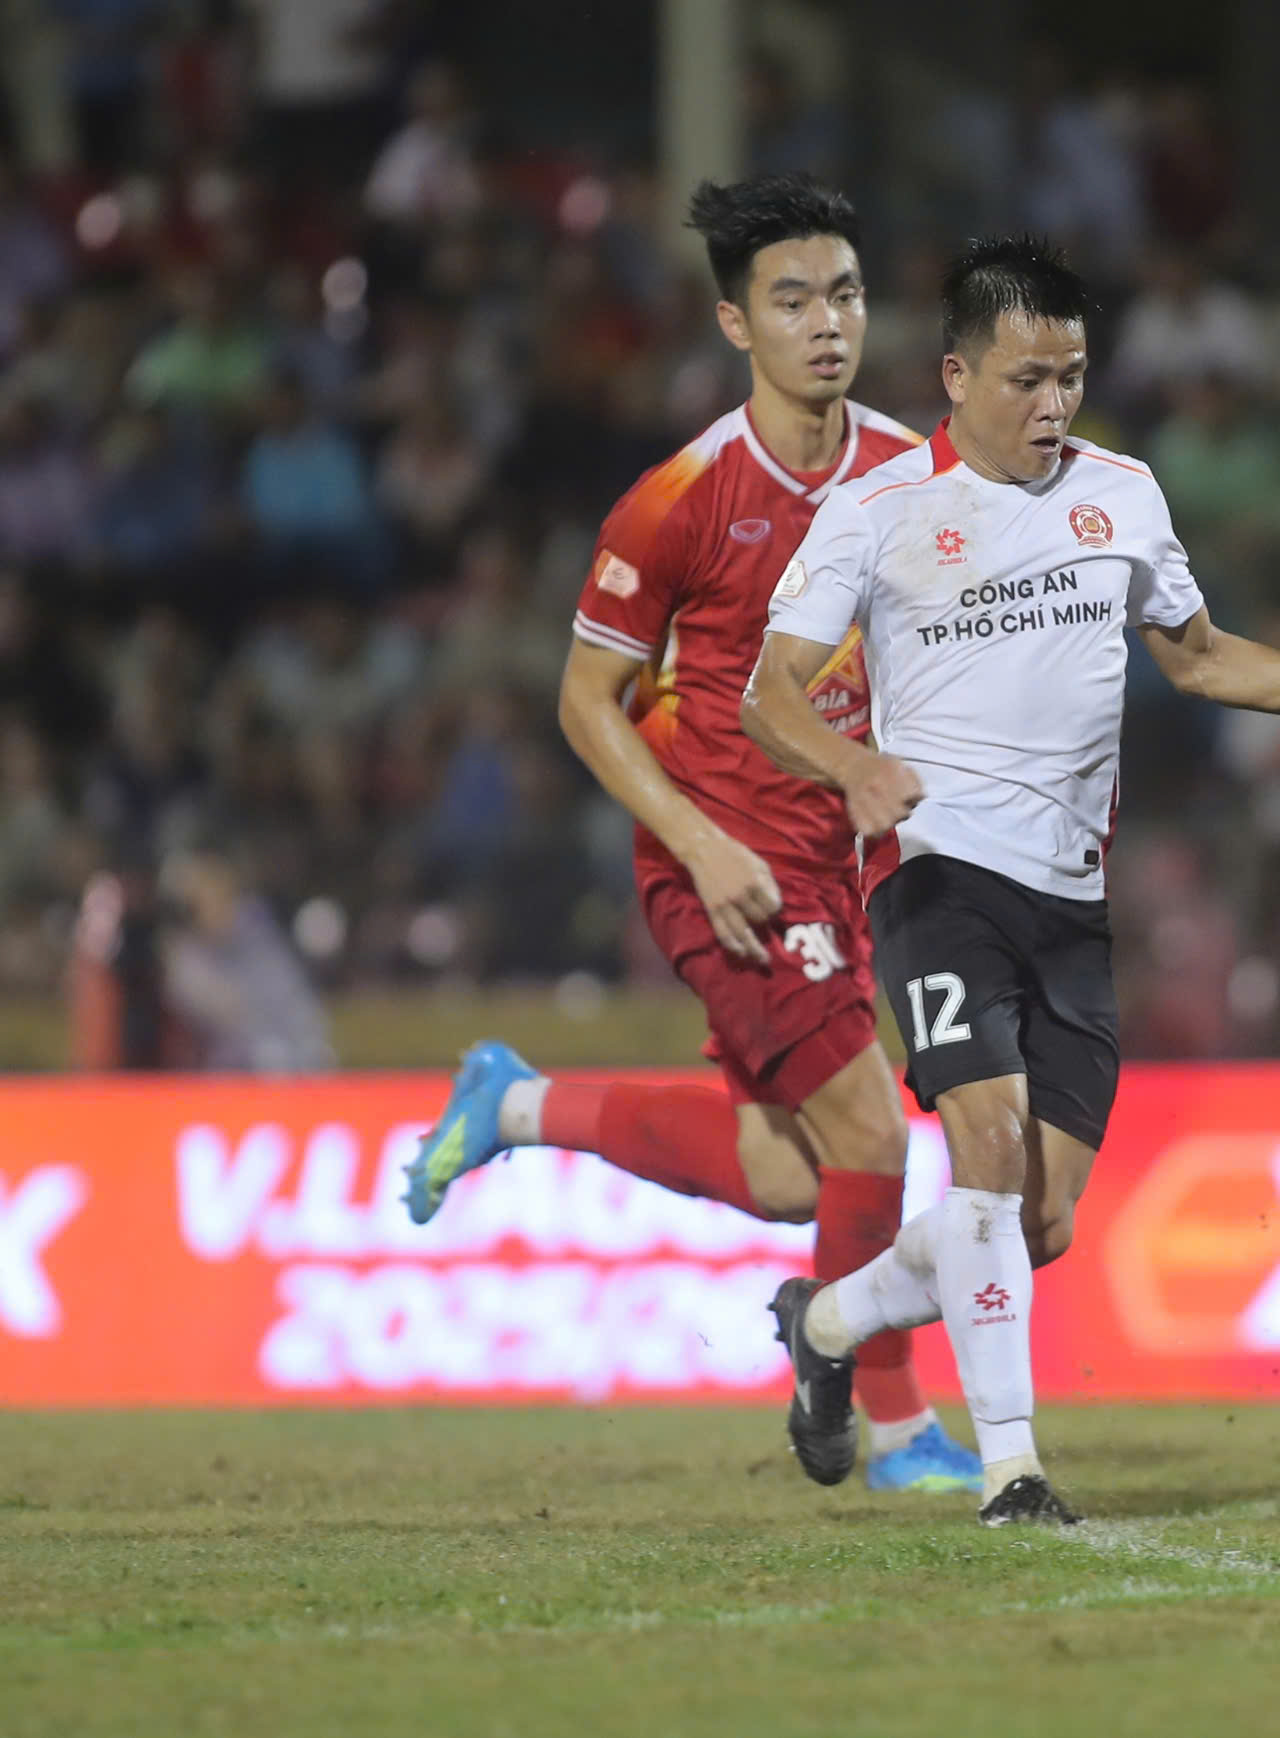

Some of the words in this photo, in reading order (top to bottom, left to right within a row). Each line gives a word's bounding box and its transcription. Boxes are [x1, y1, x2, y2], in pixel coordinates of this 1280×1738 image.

[960, 579, 1034, 608] CÔNG
[1043, 570, 1078, 595] AN
[1000, 603, 1045, 634] CHÍ
[1052, 601, 1112, 626] MINH
[906, 971, 973, 1053] 12
